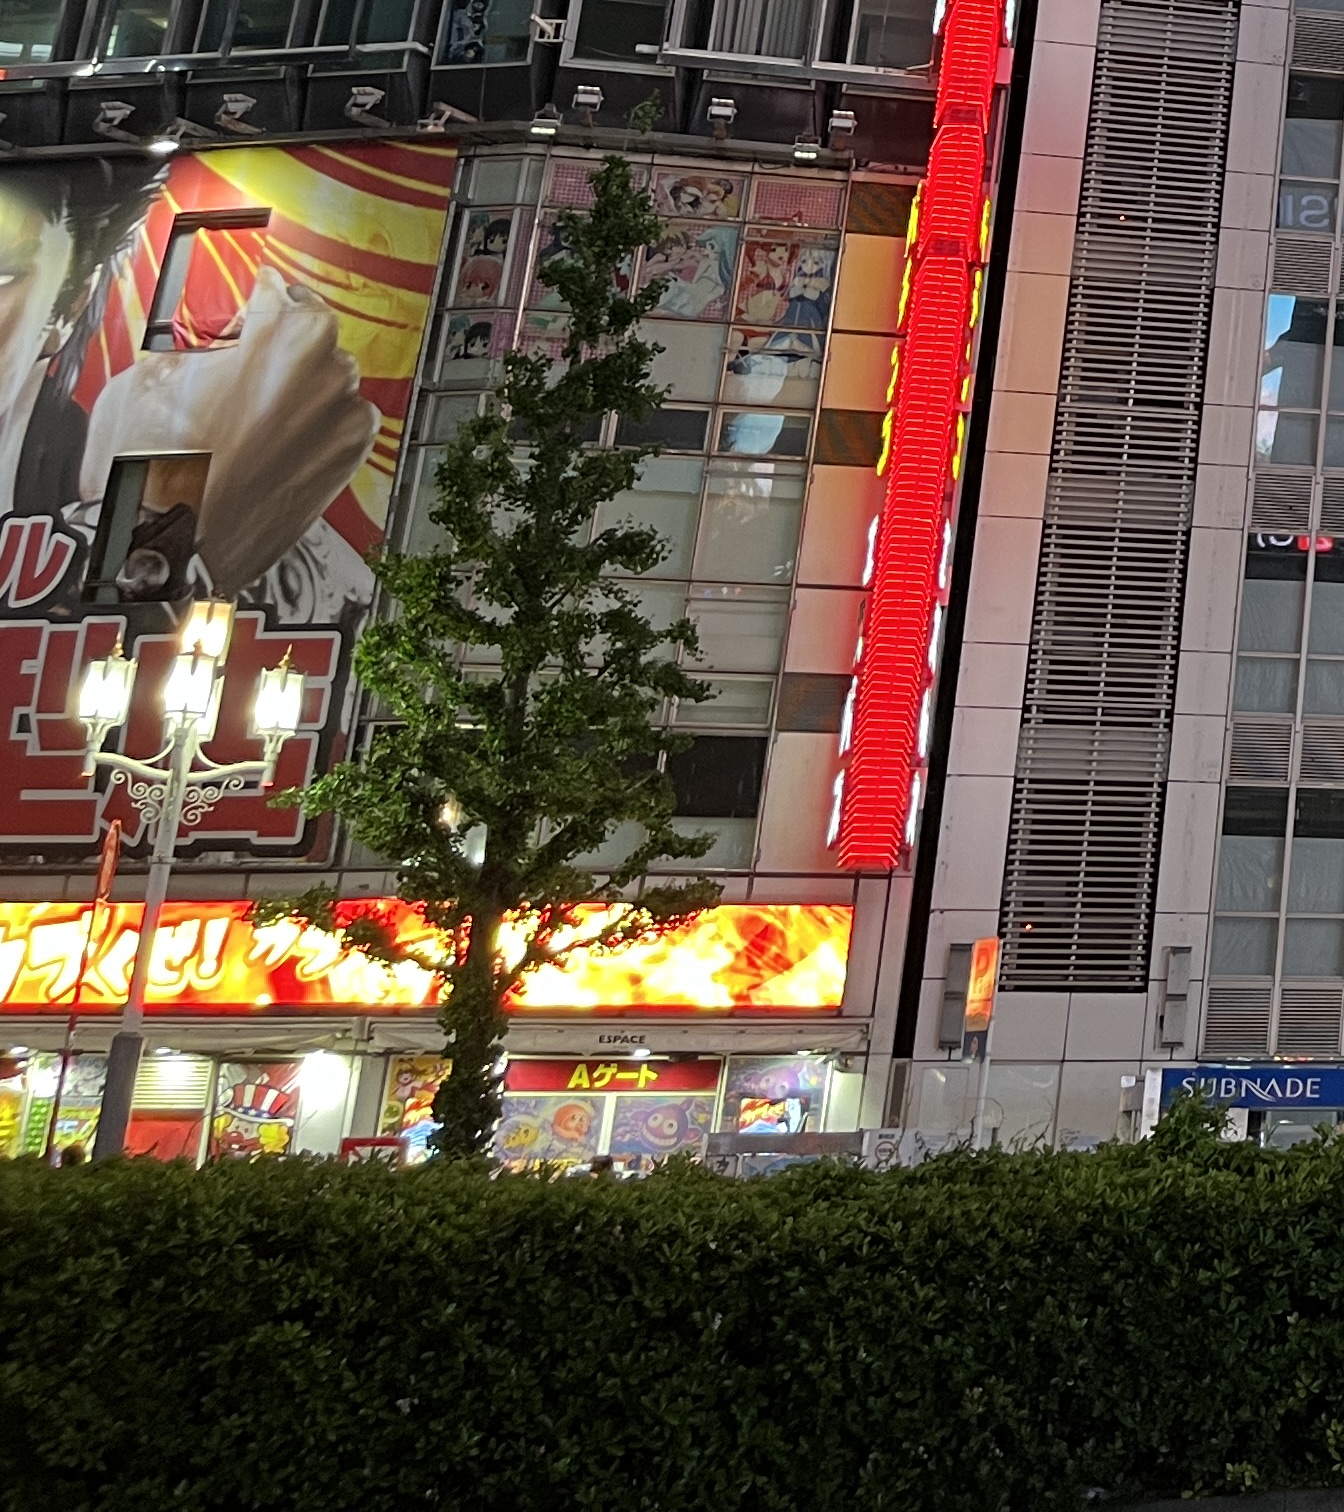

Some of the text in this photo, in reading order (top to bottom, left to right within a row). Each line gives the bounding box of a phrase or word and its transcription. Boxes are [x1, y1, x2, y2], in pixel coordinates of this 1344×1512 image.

[597, 1034, 647, 1046] ESPACE
[566, 1063, 661, 1090] Aゲート
[1180, 1075, 1322, 1102] SUBNADE
